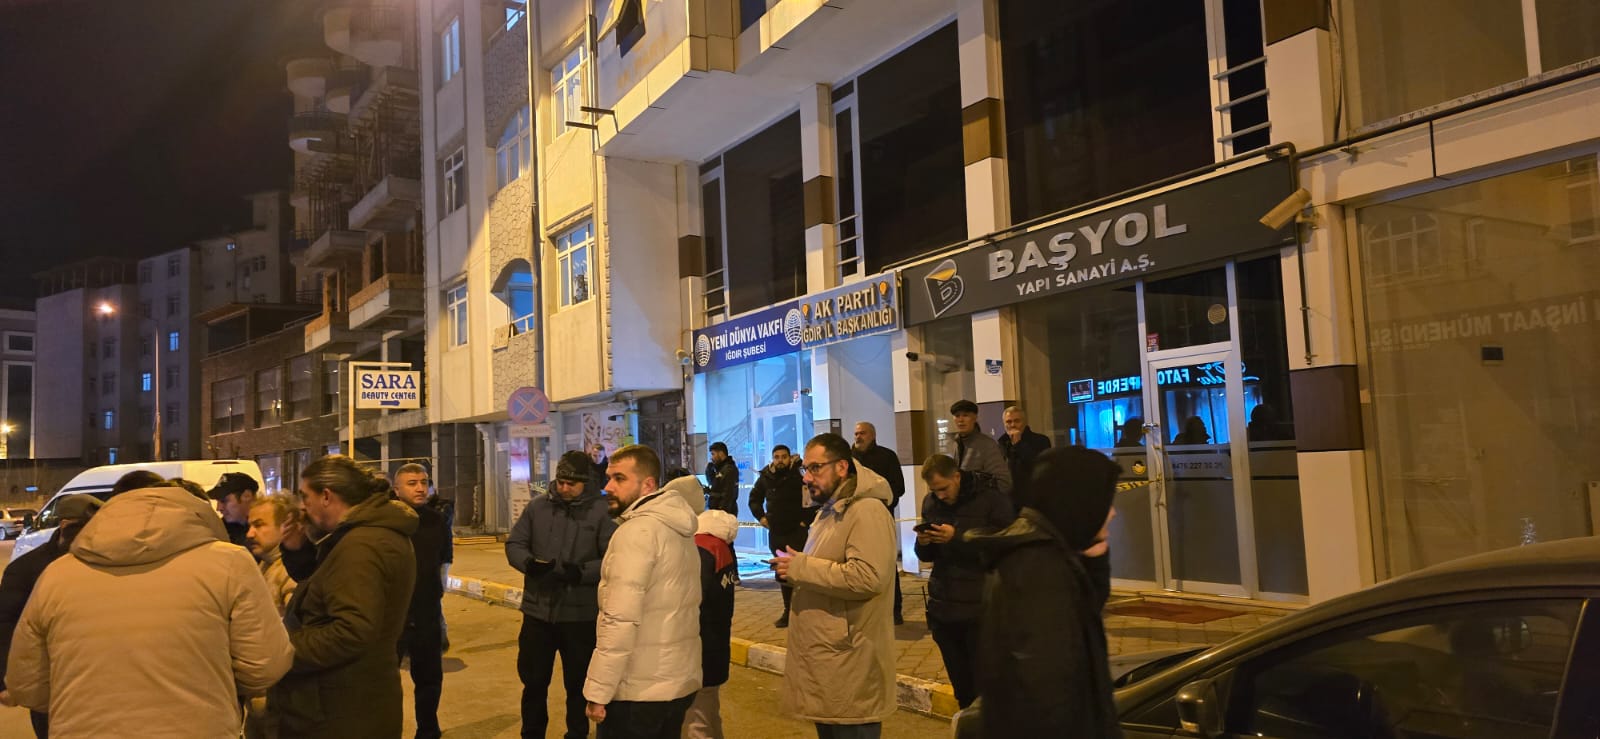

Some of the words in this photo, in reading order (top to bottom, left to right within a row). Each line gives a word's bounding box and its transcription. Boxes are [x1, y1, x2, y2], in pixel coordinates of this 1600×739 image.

[988, 203, 1187, 281] BAŞYOL
[1016, 277, 1050, 296] YAPI
[1055, 258, 1116, 287] SANAYİ
[1120, 254, 1155, 272] A.Ş.
[813, 300, 831, 320] AK
[837, 283, 875, 313] PARTİ
[710, 330, 729, 351] YENİ
[729, 326, 757, 346] DÜNYA
[757, 318, 783, 340] VAKFI
[837, 304, 892, 337] BAŞKANLIĞI
[725, 348, 742, 361] IĞDIR
[742, 341, 766, 359] ŞUBESİ
[361, 373, 416, 389] SARA
[361, 391, 389, 400] BEAUTY
[391, 391, 416, 400] CENTER
